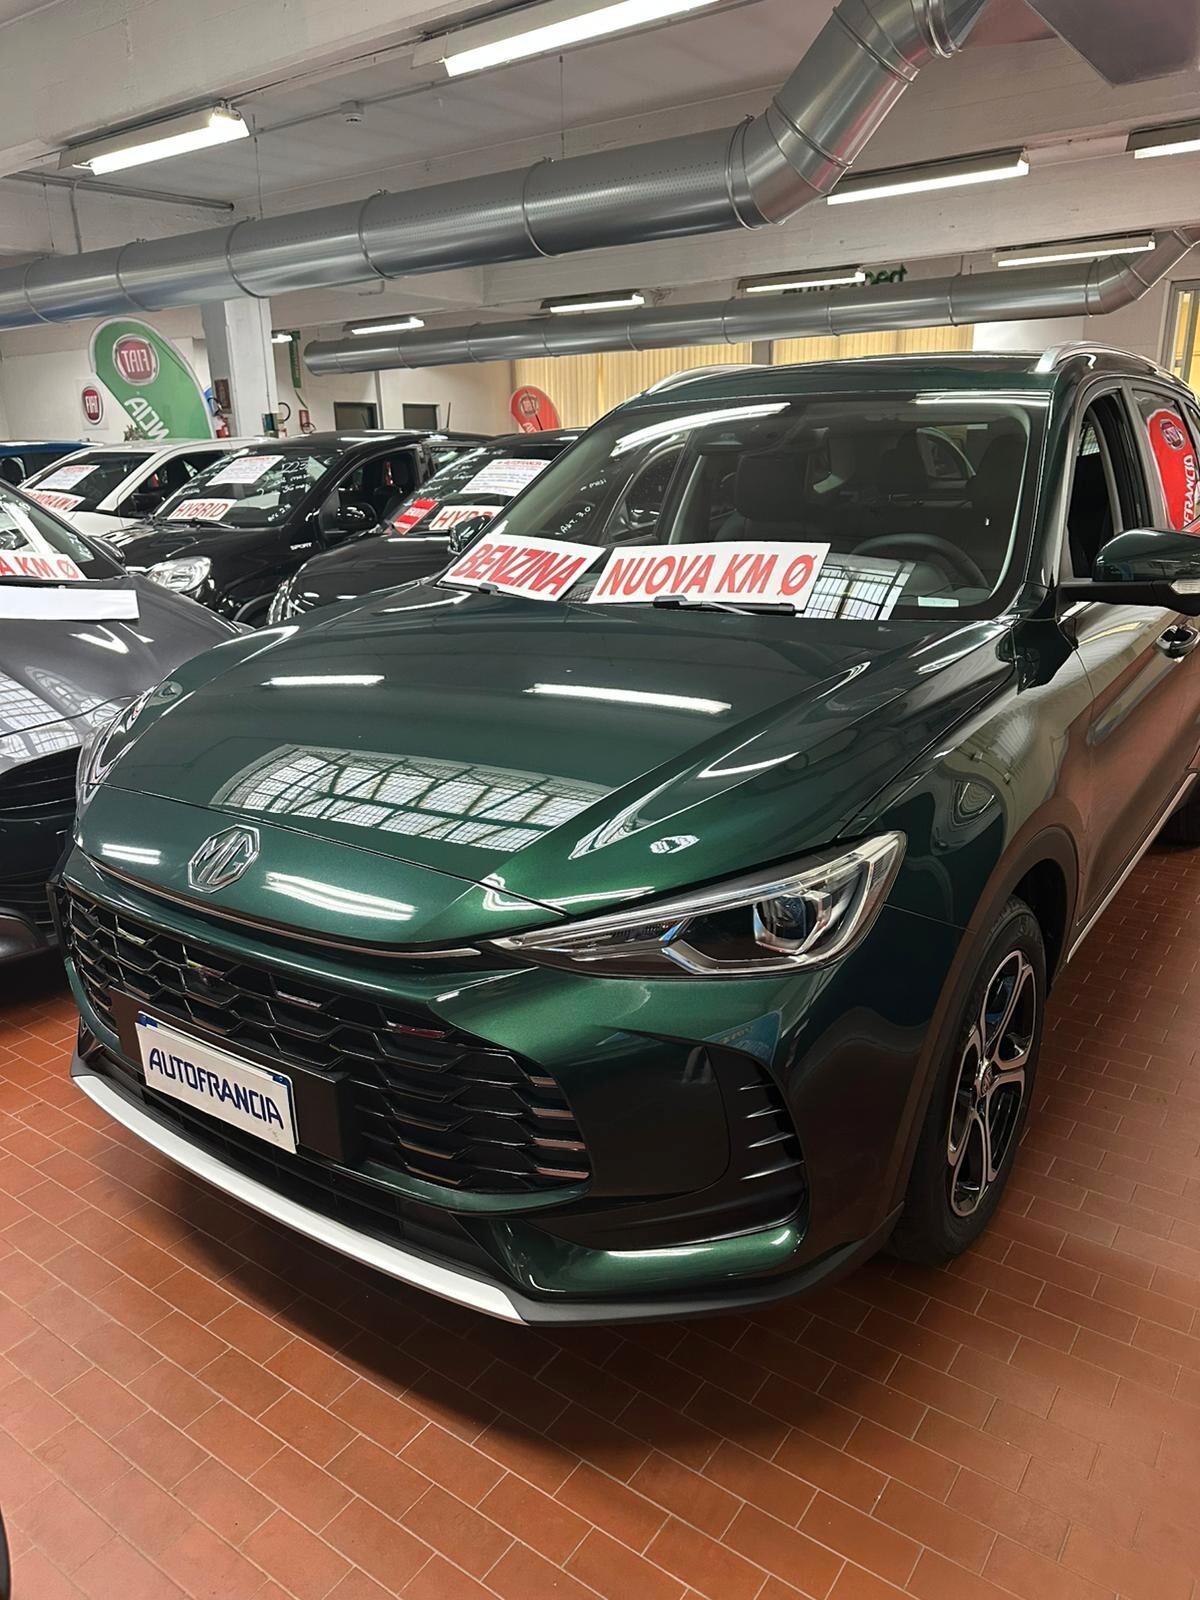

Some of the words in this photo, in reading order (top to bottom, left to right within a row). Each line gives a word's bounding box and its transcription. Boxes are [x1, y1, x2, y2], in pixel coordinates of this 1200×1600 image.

[175, 502, 229, 518] HYBRID
[14, 555, 58, 578] KM
[451, 543, 587, 595] BENZINA
[598, 554, 715, 596] NUOVA
[714, 553, 778, 594] KM
[149, 1048, 285, 1130] AUTOFRANCIA
